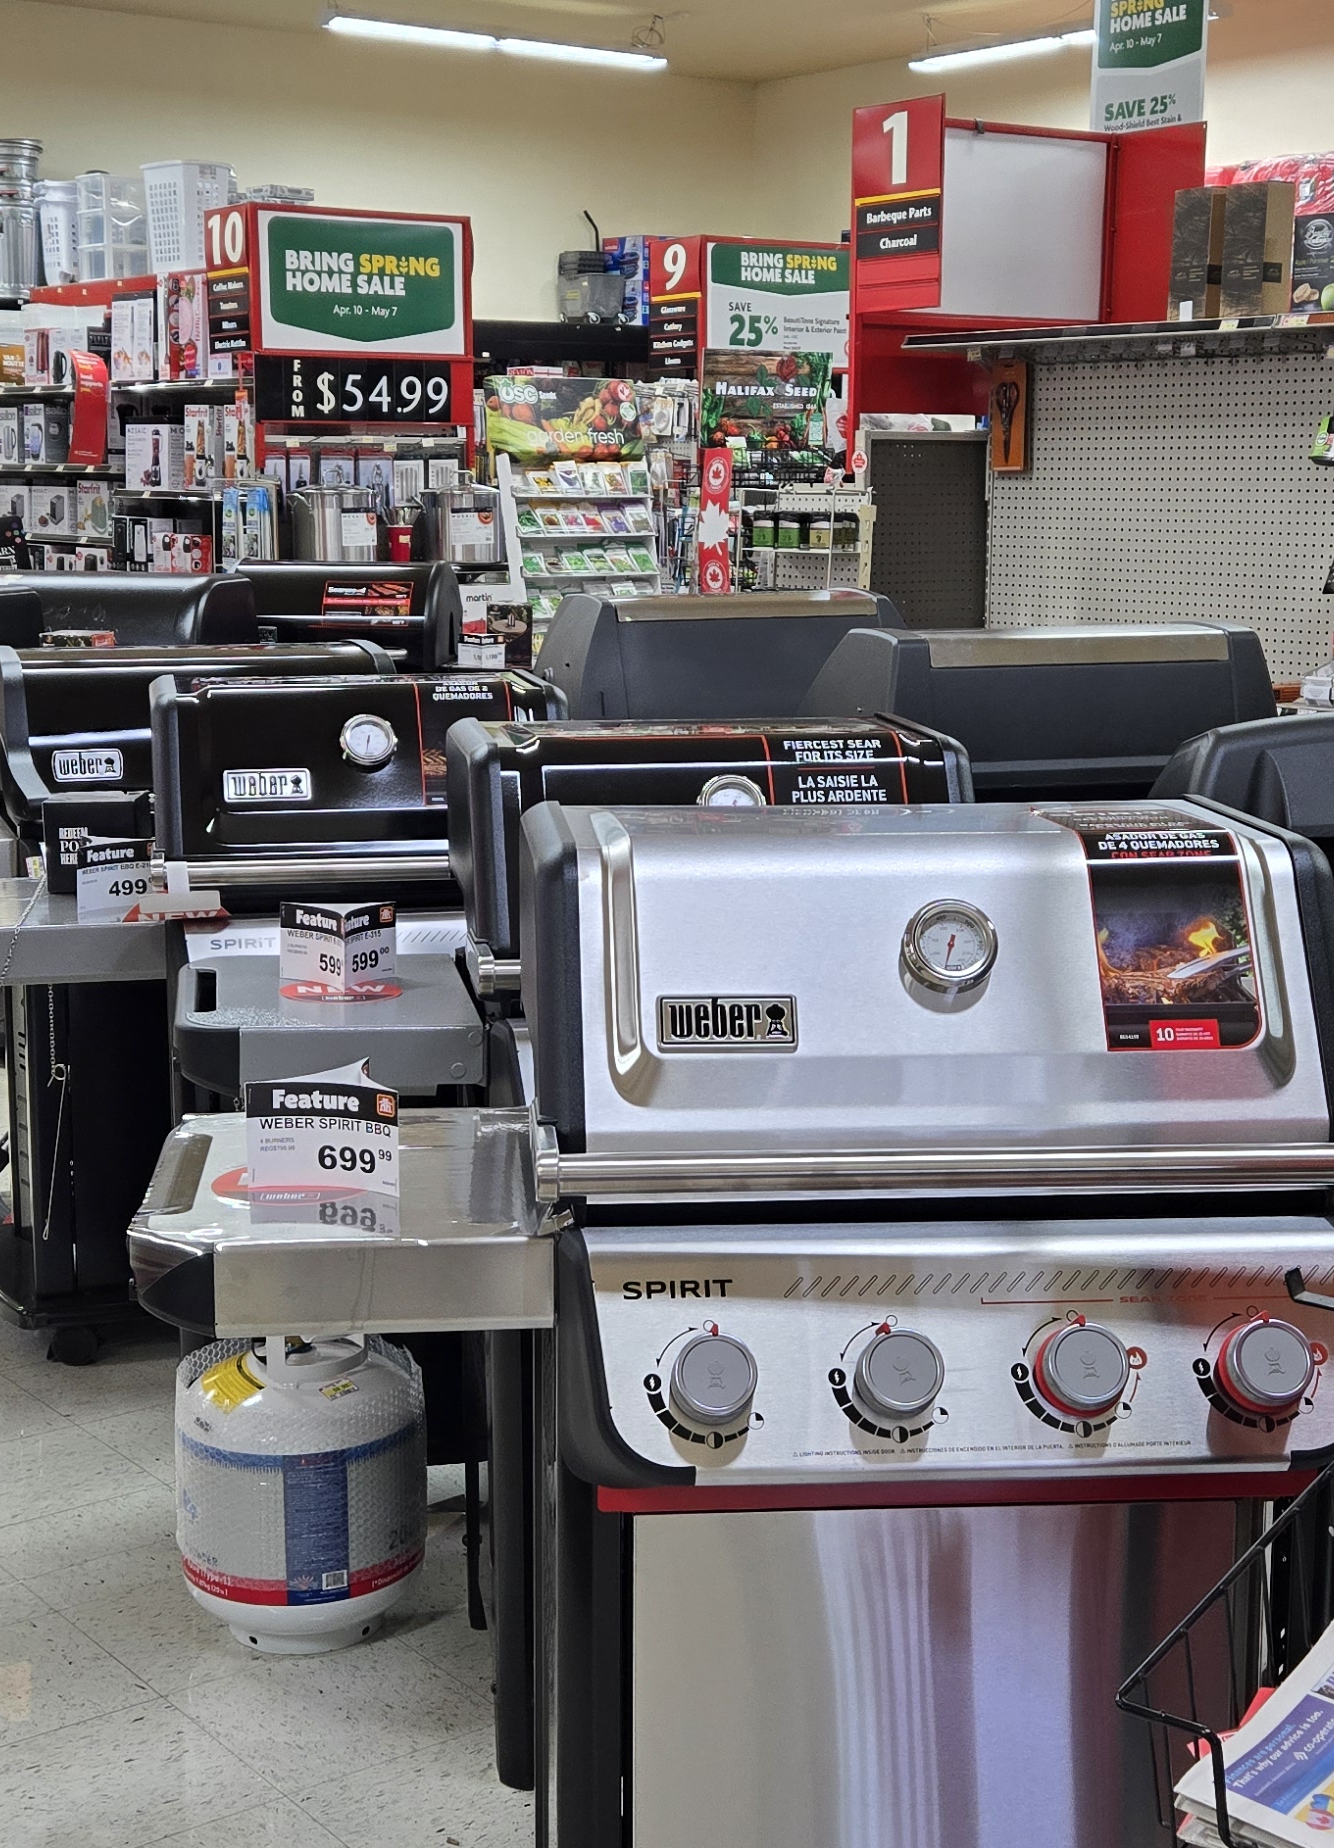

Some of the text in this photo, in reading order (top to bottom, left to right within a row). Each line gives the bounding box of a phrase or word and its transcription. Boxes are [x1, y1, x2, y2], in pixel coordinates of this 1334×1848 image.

[1110, 0, 1165, 17] SPRING
[1109, 4, 1187, 34] HOME SALE
[1109, 33, 1163, 54] Apr. 10 May 7
[1104, 93, 1176, 122] SAVE 25%
[1104, 115, 1176, 132] Wood-Shield Best Stain
[882, 110, 908, 185] 1
[866, 206, 932, 225] Barbeque Parts
[207, 211, 244, 265] 10
[879, 234, 917, 250] Charcoal
[284, 249, 441, 277] BRING SPRING
[663, 243, 687, 291] 9
[740, 251, 838, 271] BRING SPRING
[285, 271, 406, 296] HOME SALE
[740, 267, 816, 285] HOME SALE
[332, 303, 398, 319] Apr. 10 May 7
[728, 301, 752, 312] SAVE
[728, 313, 779, 348] 25%
[783, 316, 840, 327] BeautiTone Signature
[832, 327, 847, 335] Paint
[291, 358, 305, 418] FROM
[316, 371, 449, 414] $54.99
[715, 381, 818, 397] HALIFAX SEED
[185, 407, 208, 418] Starfrit
[527, 427, 625, 446] garden fresh
[78, 483, 102, 494] Starfrit
[432, 692, 494, 701] QUEMADORES
[783, 739, 882, 750] FIERCEST SEAR
[58, 752, 104, 776] weber
[795, 750, 875, 762] FOR ITS SIZE
[231, 771, 290, 797] weber
[797, 774, 879, 788] LA SAISIE LA
[791, 788, 887, 804] PLUS ARDENTE
[1098, 839, 1220, 851] DE 4 QUEMADORES
[1104, 831, 1206, 841] ASADOR DE GAS
[86, 846, 135, 864] Feature
[81, 867, 100, 876] WEBER
[100, 865, 119, 874] SPIRIT
[108, 879, 148, 897] 499
[295, 909, 337, 932] Feature
[210, 936, 277, 951] SPIRIT
[287, 930, 314, 939] WEBER
[319, 953, 342, 977] 599
[351, 949, 379, 973] 599
[668, 997, 763, 1040] weber
[1155, 1027, 1175, 1042] 10
[271, 1088, 360, 1112] Feature
[259, 1118, 392, 1138] WEBER SPIRIT BBQ
[317, 1145, 393, 1174] 699 99
[622, 1278, 733, 1300] SPIRIT
